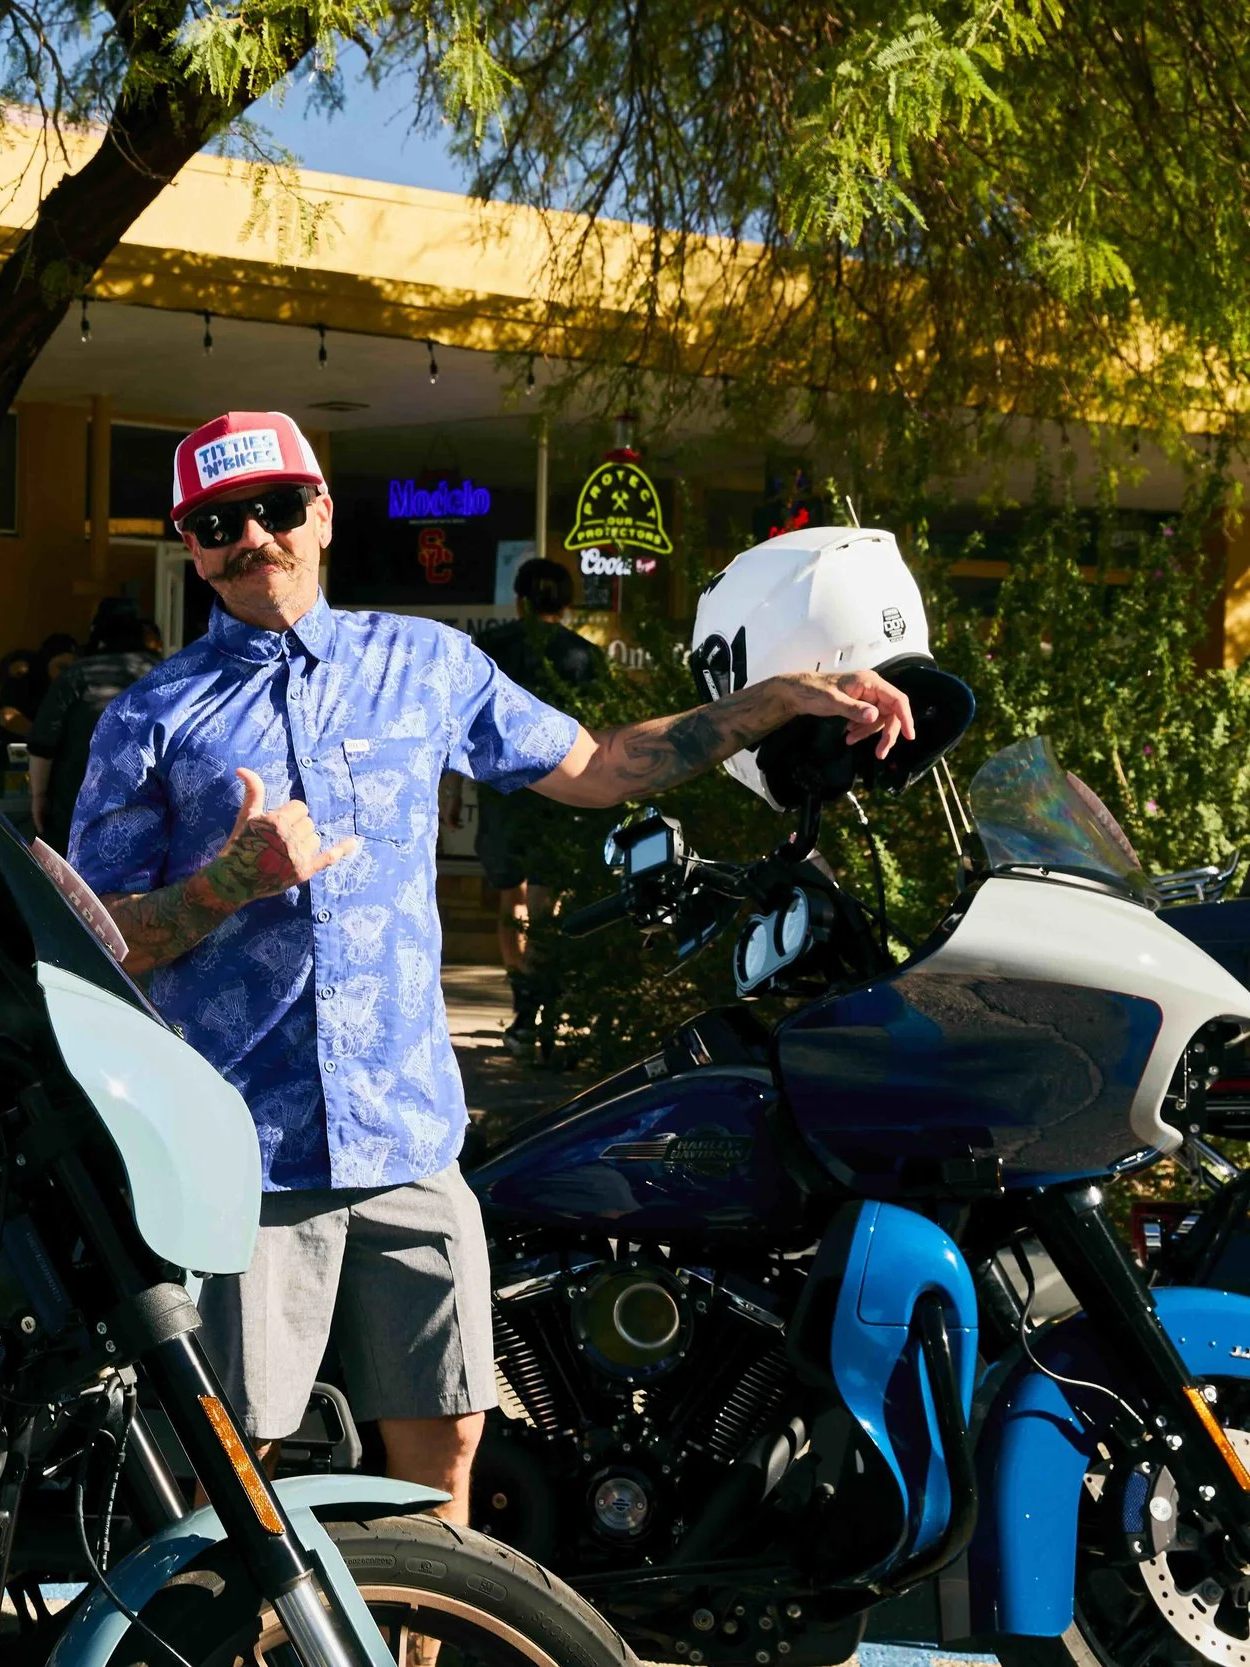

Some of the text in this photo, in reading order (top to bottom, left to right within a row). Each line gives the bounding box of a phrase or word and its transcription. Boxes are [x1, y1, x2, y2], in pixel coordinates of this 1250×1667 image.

[198, 435, 274, 465] TITTIES
[388, 478, 492, 519] Modelo
[583, 469, 657, 519] PROTECT
[607, 516, 634, 526] OUR
[577, 527, 662, 546] PROTECTORS
[884, 617, 905, 632] DOT
